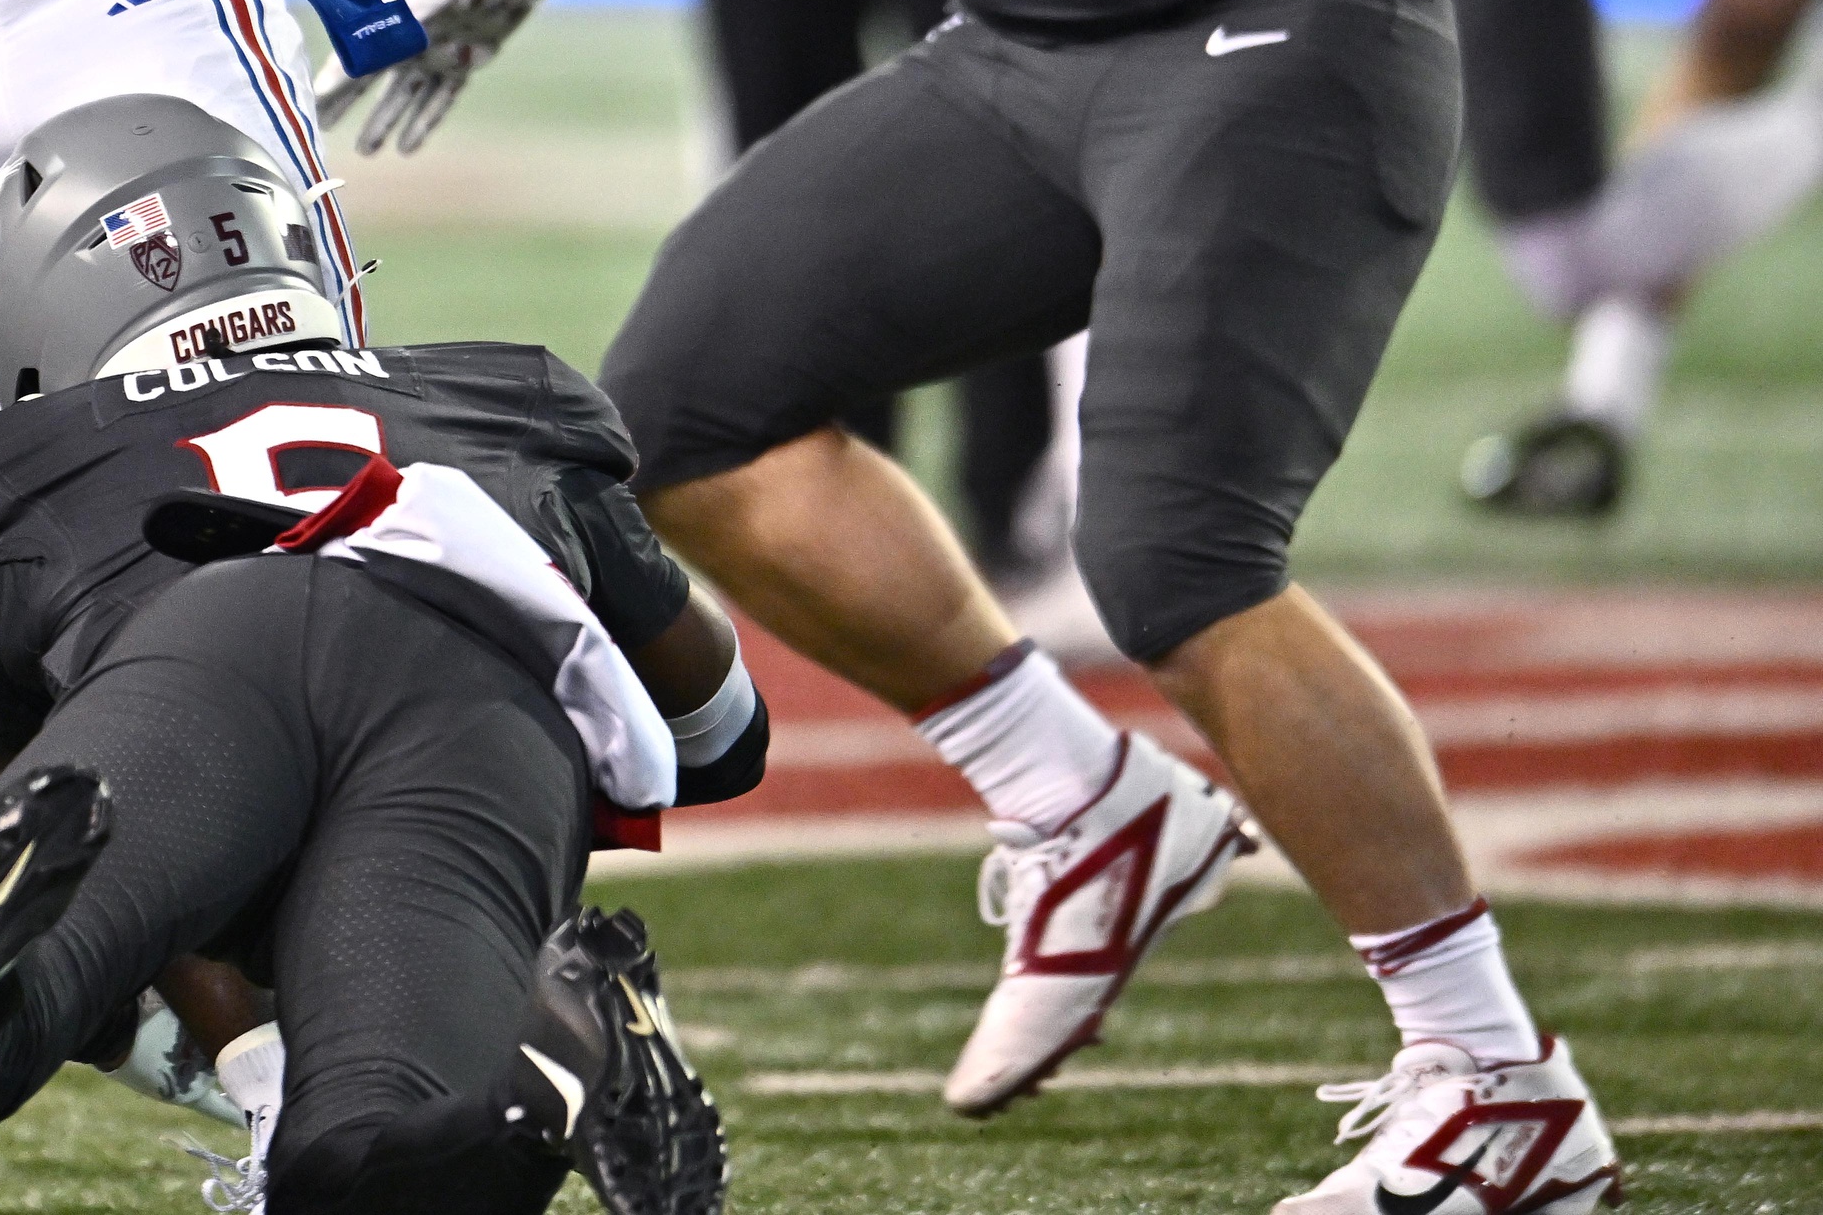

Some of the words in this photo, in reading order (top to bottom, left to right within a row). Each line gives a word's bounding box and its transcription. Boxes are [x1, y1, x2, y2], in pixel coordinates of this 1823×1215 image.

[208, 211, 250, 267] 5
[149, 257, 177, 282] 12
[169, 301, 296, 364] COUGARS
[123, 350, 390, 402] COLSON
